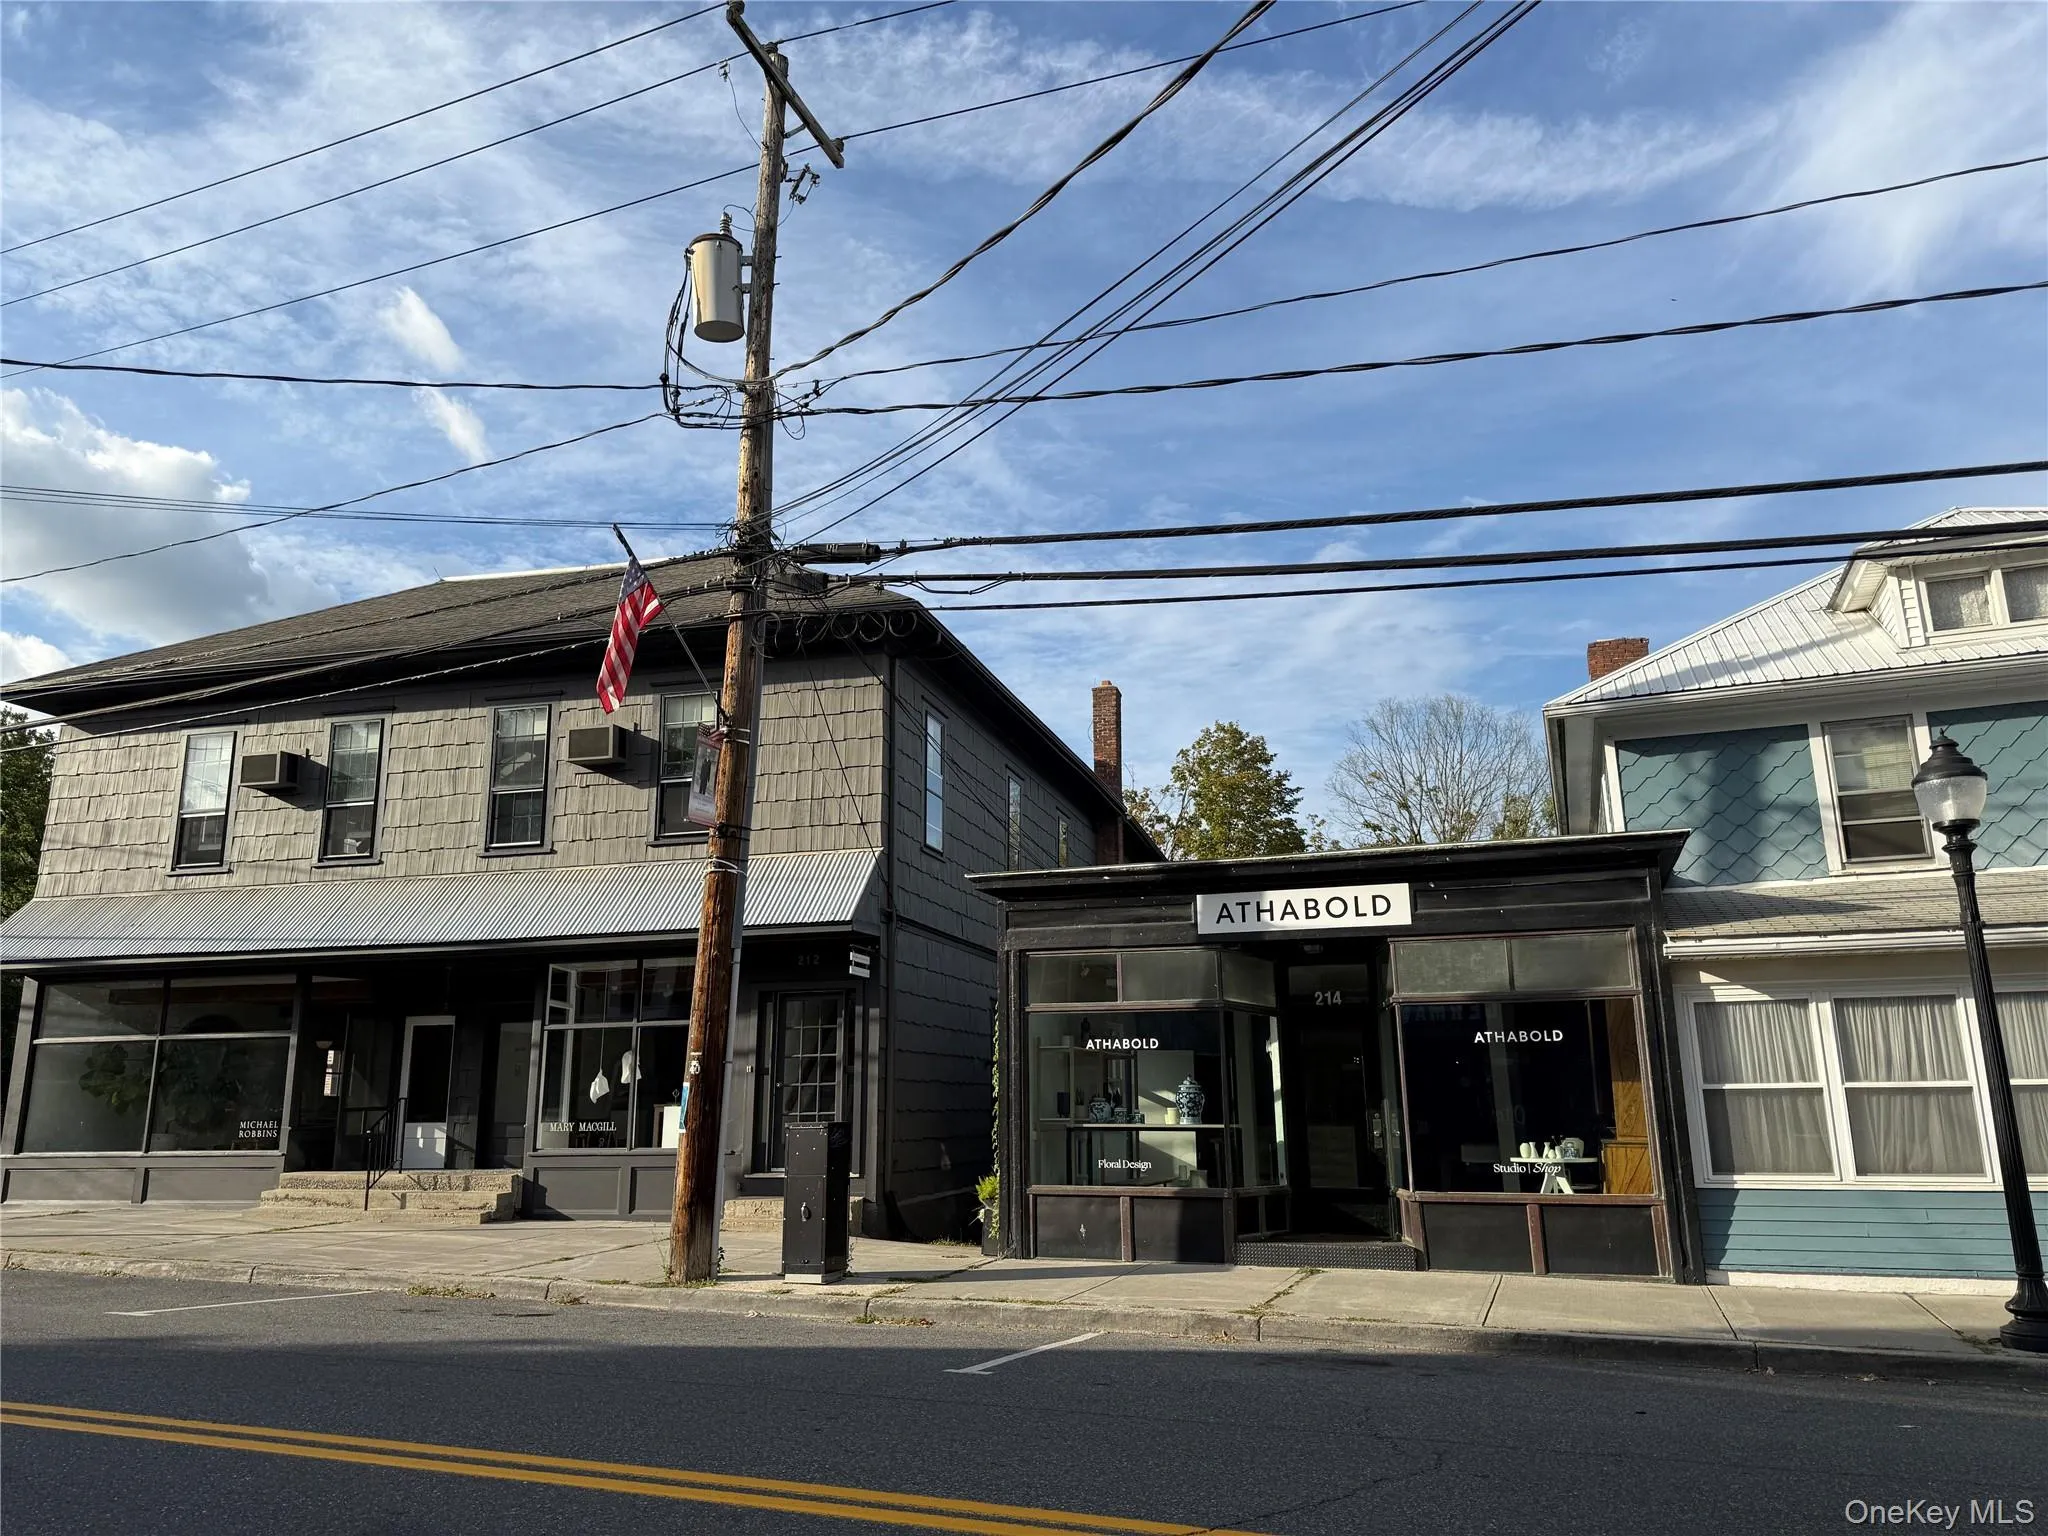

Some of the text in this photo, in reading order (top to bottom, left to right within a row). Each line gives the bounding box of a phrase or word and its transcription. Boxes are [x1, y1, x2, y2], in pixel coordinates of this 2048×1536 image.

[1216, 894, 1392, 924] ATHABOLD
[797, 954, 820, 966] 212
[1314, 991, 1342, 1006] 214
[1474, 1029, 1564, 1044] ATHABOLD
[1085, 1038, 1159, 1050] ATHABOLD
[239, 1120, 279, 1129] MICHAEL
[549, 1121, 617, 1132] MARY MACGILL
[238, 1129, 278, 1139] ROBBINS
[1097, 1158, 1152, 1172] Floral Design
[1493, 1162, 1527, 1174] Studio
[1532, 1162, 1561, 1176] Shop
